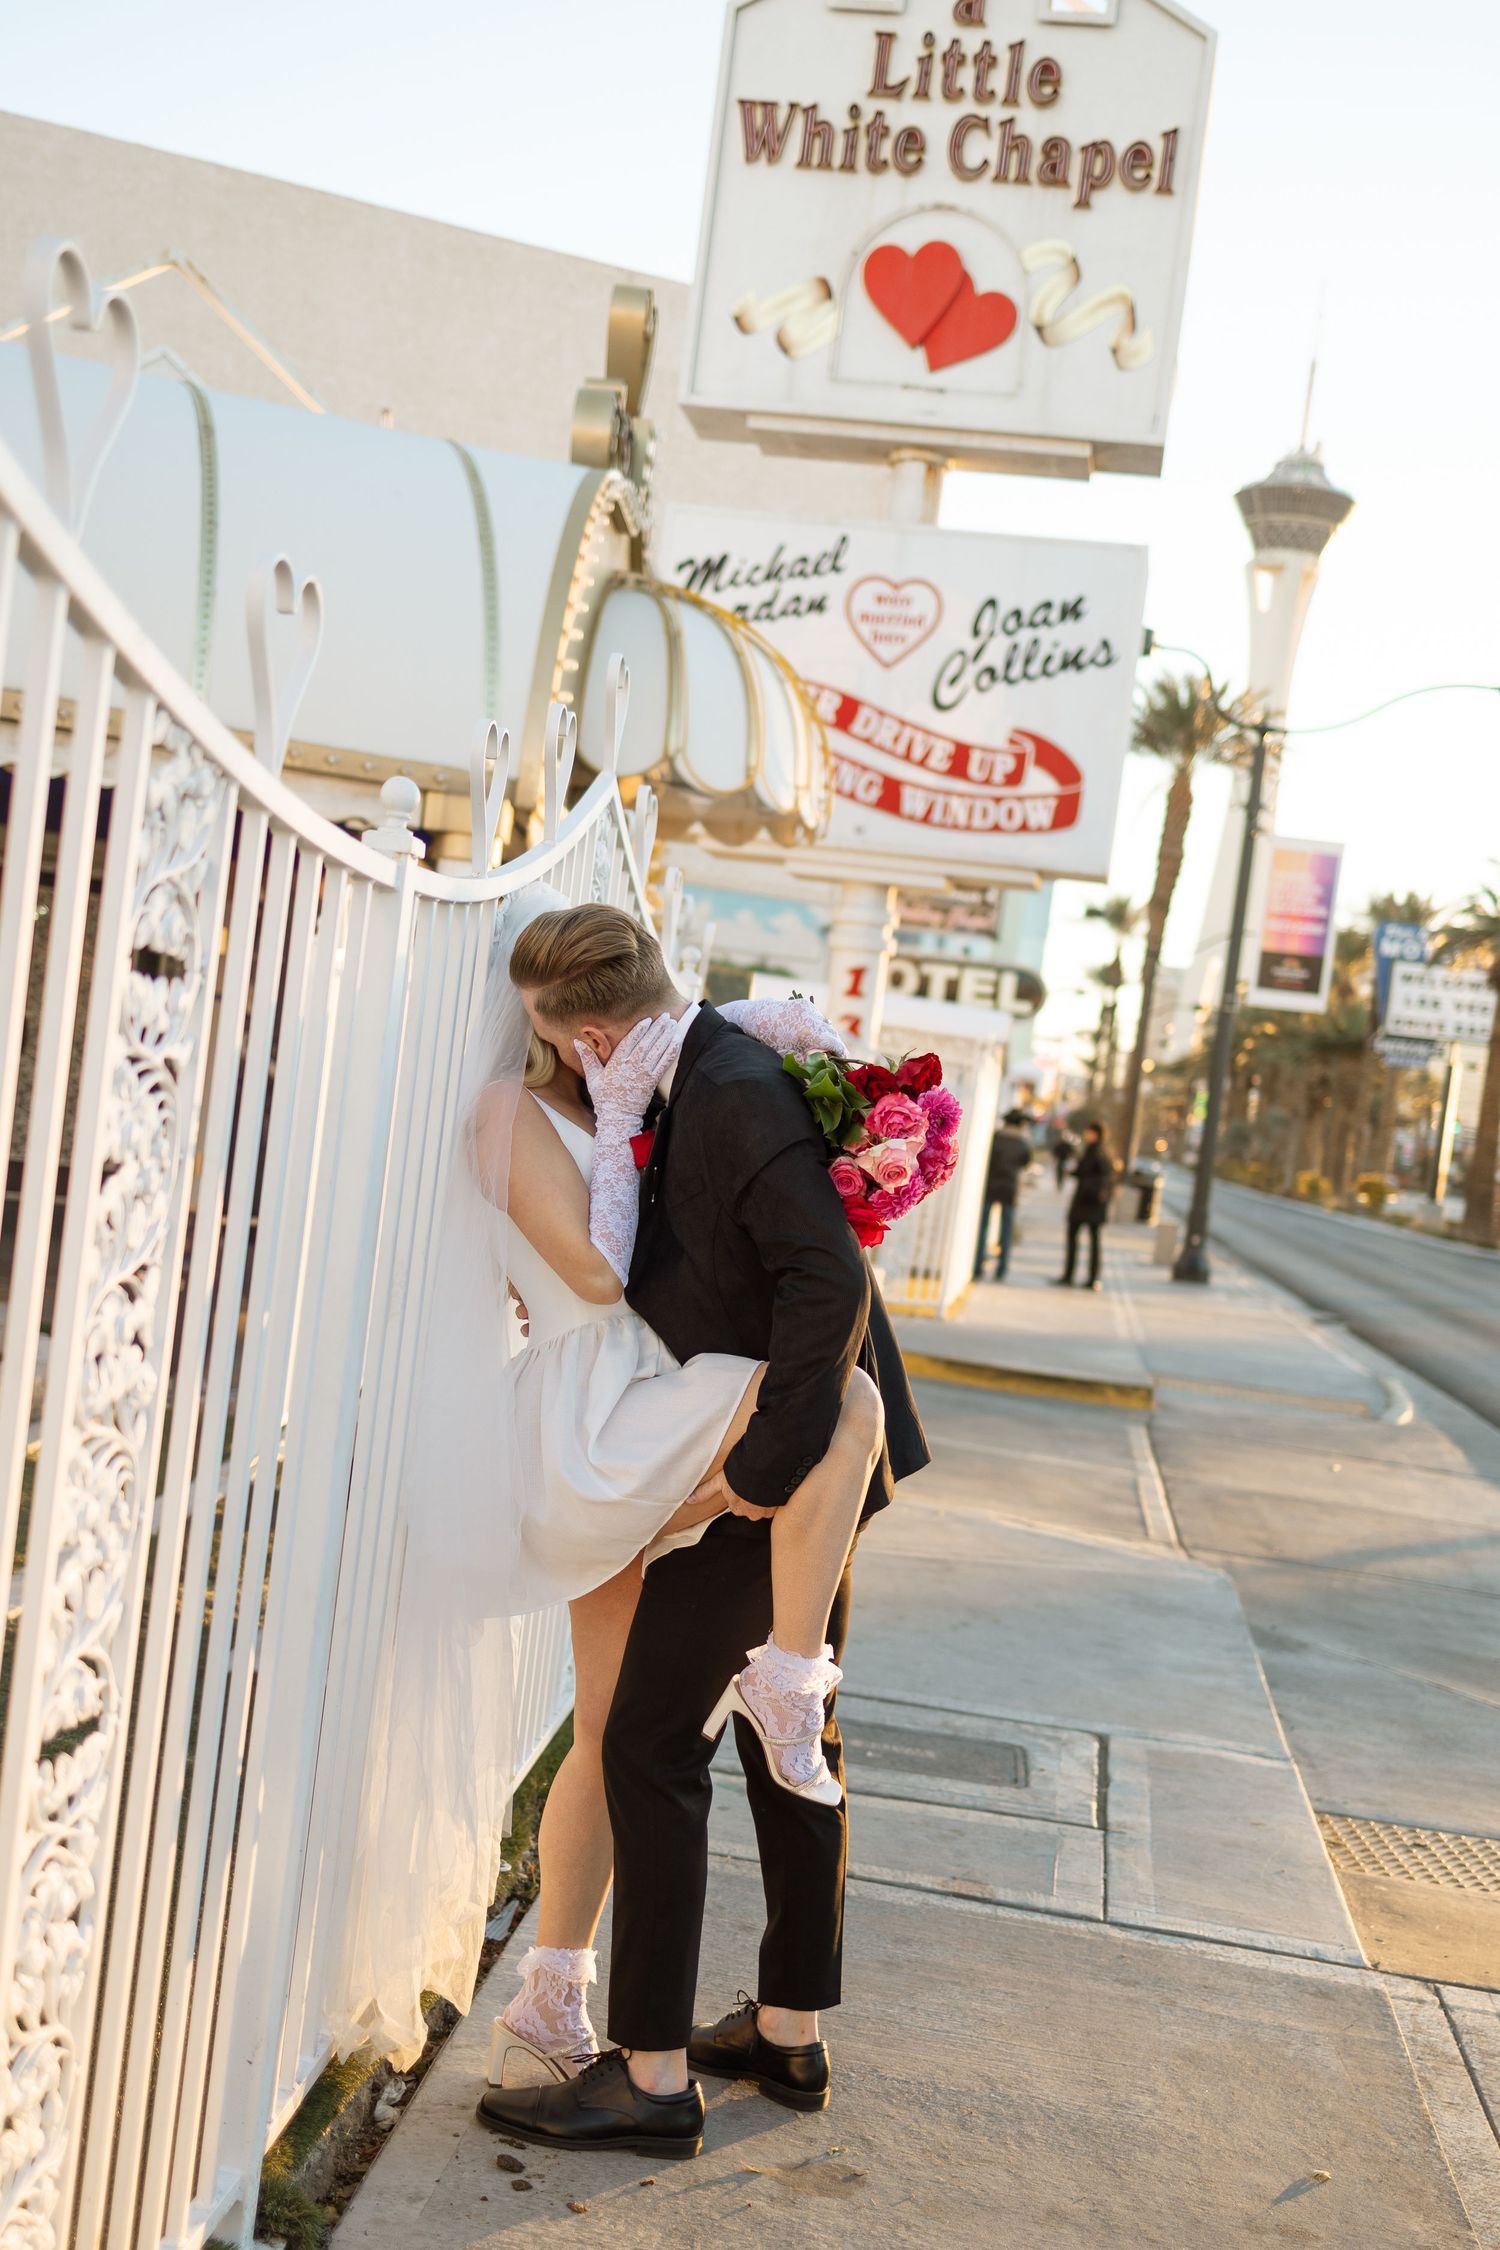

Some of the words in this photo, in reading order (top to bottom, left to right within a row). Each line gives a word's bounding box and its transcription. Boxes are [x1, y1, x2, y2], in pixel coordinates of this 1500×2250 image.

[867, 30, 1063, 107] Little
[738, 99, 926, 175] White
[948, 113, 1180, 210] Chapel
[676, 533, 848, 594] Michael
[733, 582, 828, 622] rdan
[971, 595, 1085, 663] Joan
[931, 637, 1118, 712] Collins
[848, 705, 957, 773] DRIVE
[966, 747, 1017, 785] UP
[900, 782, 1058, 831] WINDOW
[886, 957, 1035, 1015] OTEL
